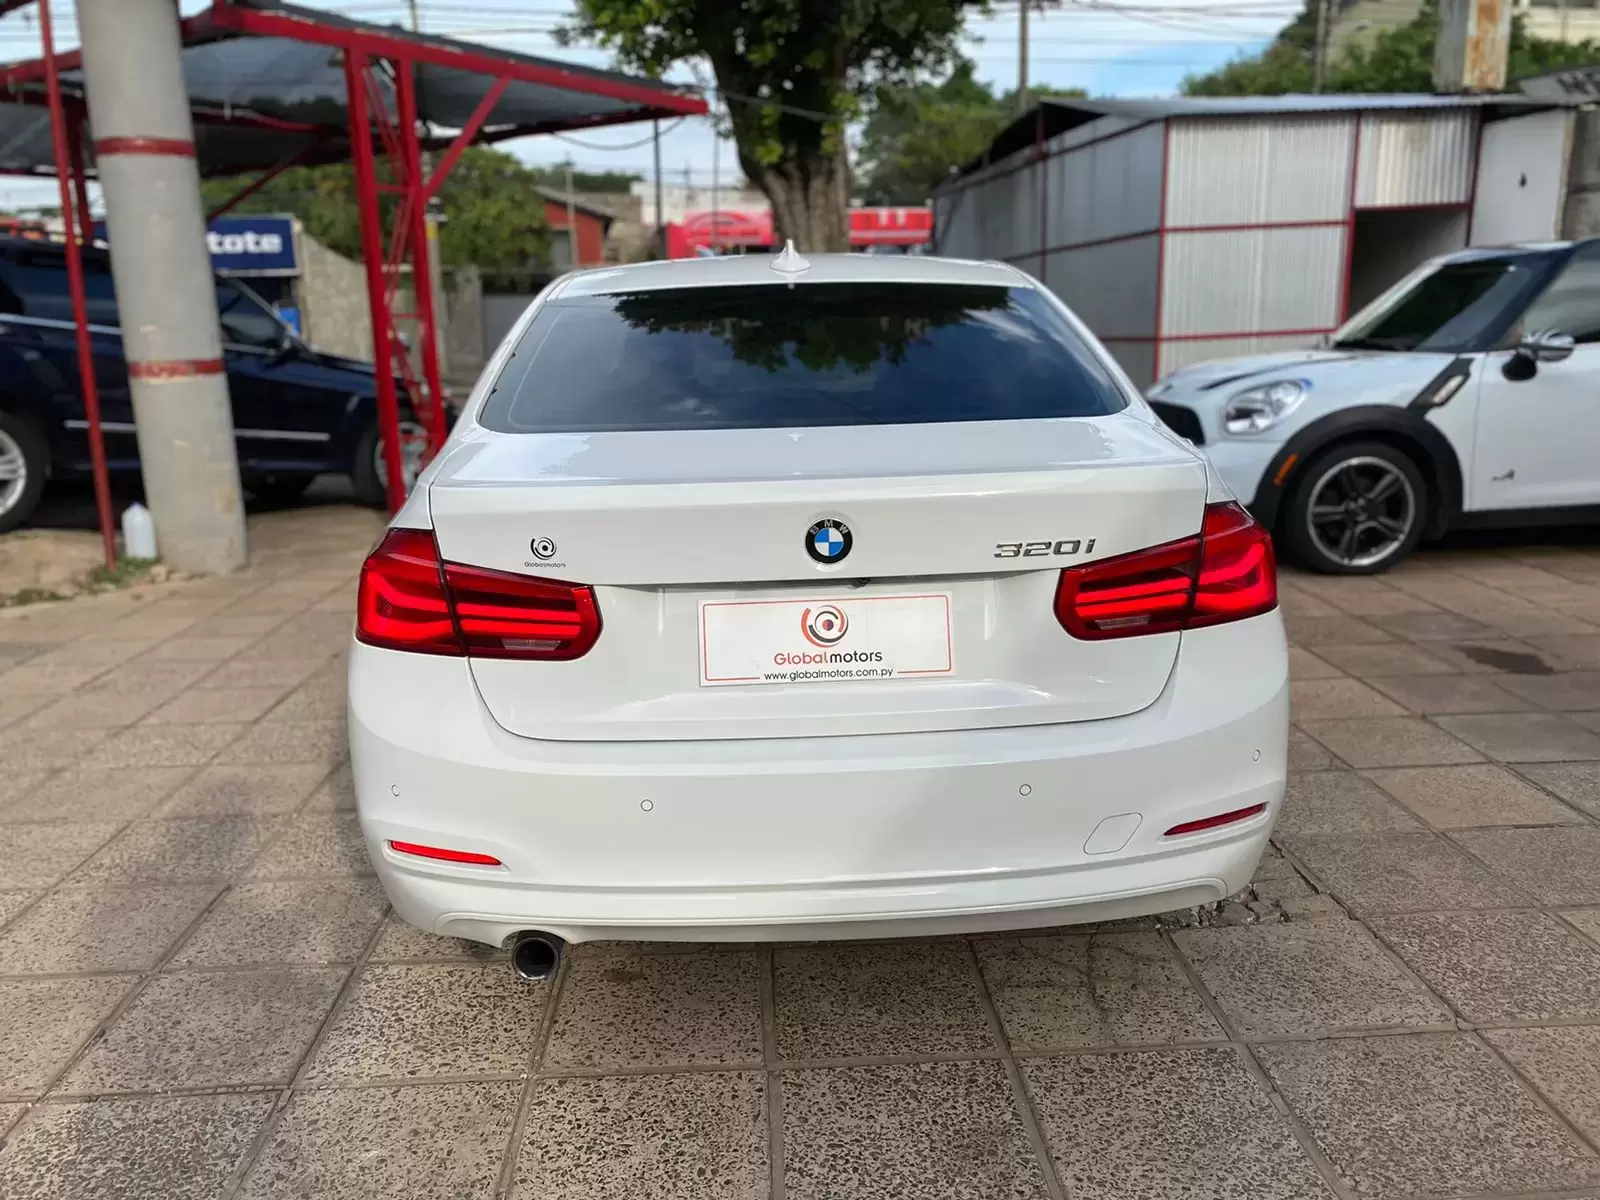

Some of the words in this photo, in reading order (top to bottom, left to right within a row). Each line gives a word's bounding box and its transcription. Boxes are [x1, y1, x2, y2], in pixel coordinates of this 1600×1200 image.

[809, 519, 849, 535] BMW
[994, 538, 1096, 558] 320i
[773, 650, 883, 666] Globalmotors
[764, 667, 893, 681] www.globalmotors.com.py
